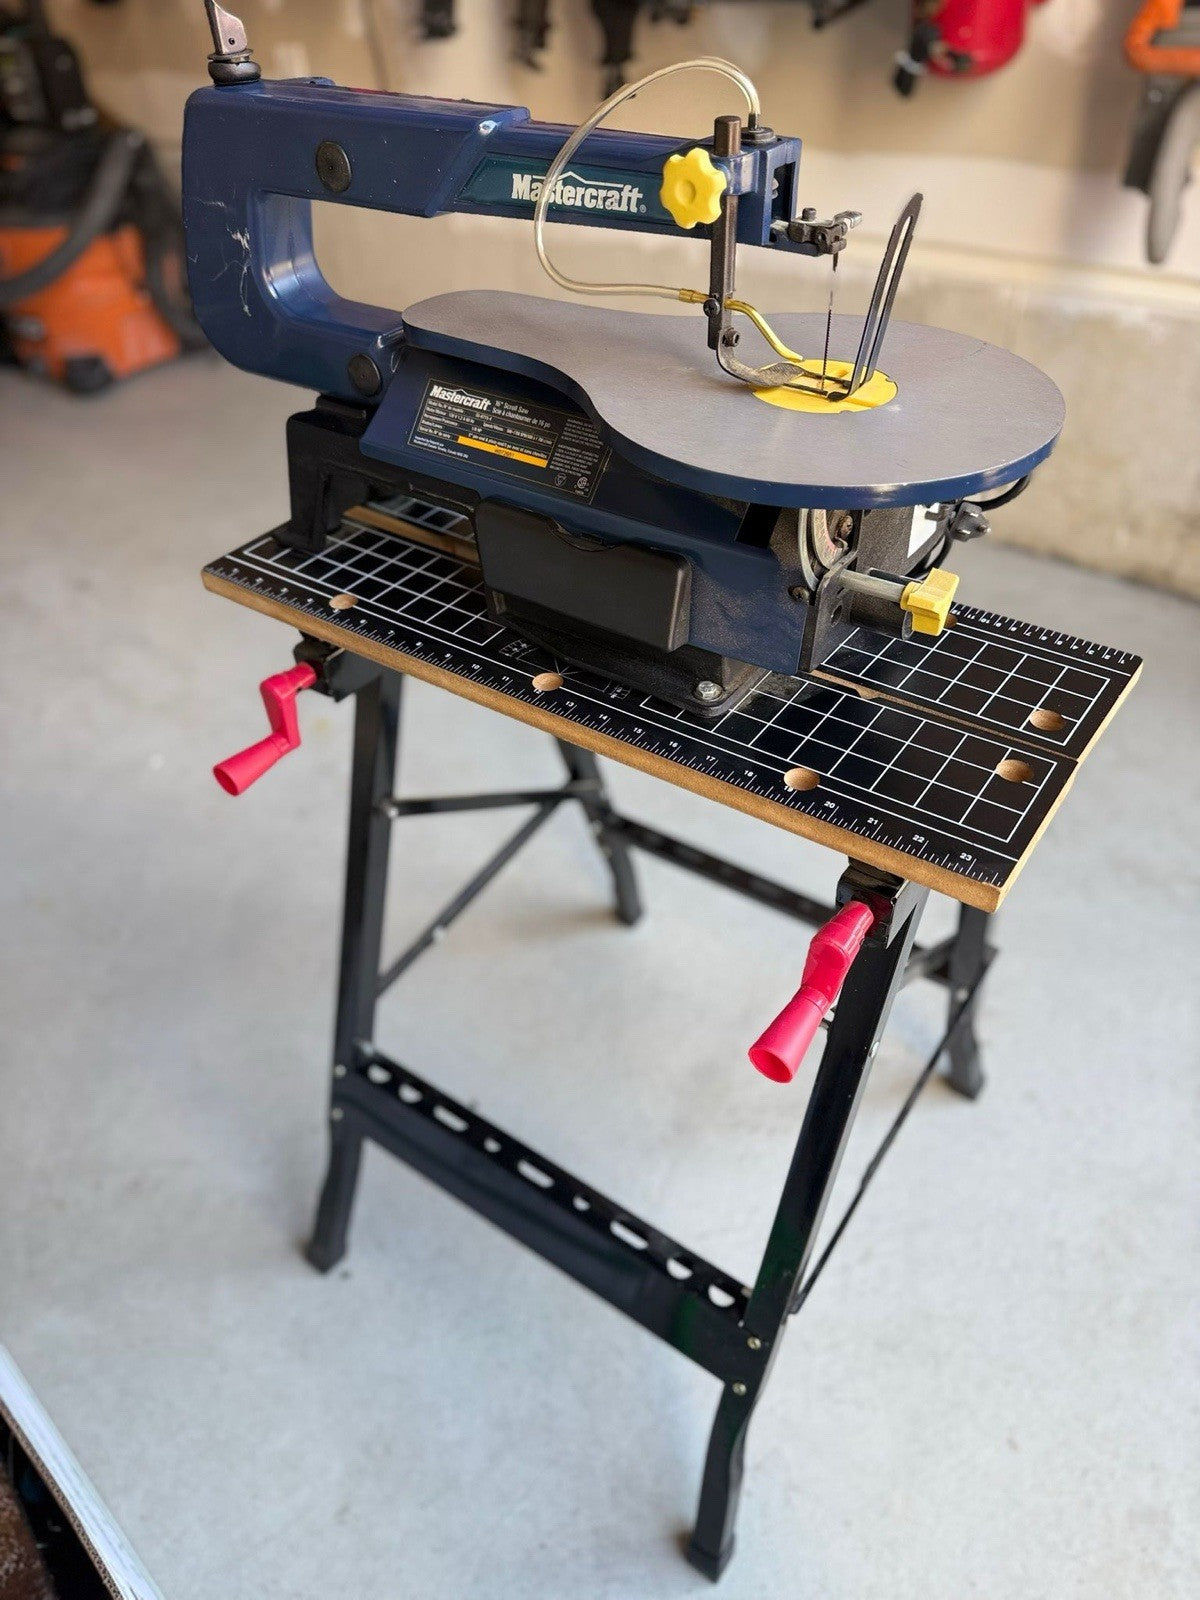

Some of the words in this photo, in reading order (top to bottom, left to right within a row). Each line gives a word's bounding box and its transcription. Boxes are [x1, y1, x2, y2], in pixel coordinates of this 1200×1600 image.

[430, 385, 491, 411] Mastercraft
[503, 401, 518, 413] Scroll
[518, 405, 529, 414] Saw
[824, 801, 836, 809] 20
[867, 817, 879, 825] 21
[912, 834, 925, 843] 22
[959, 852, 972, 861] 23
